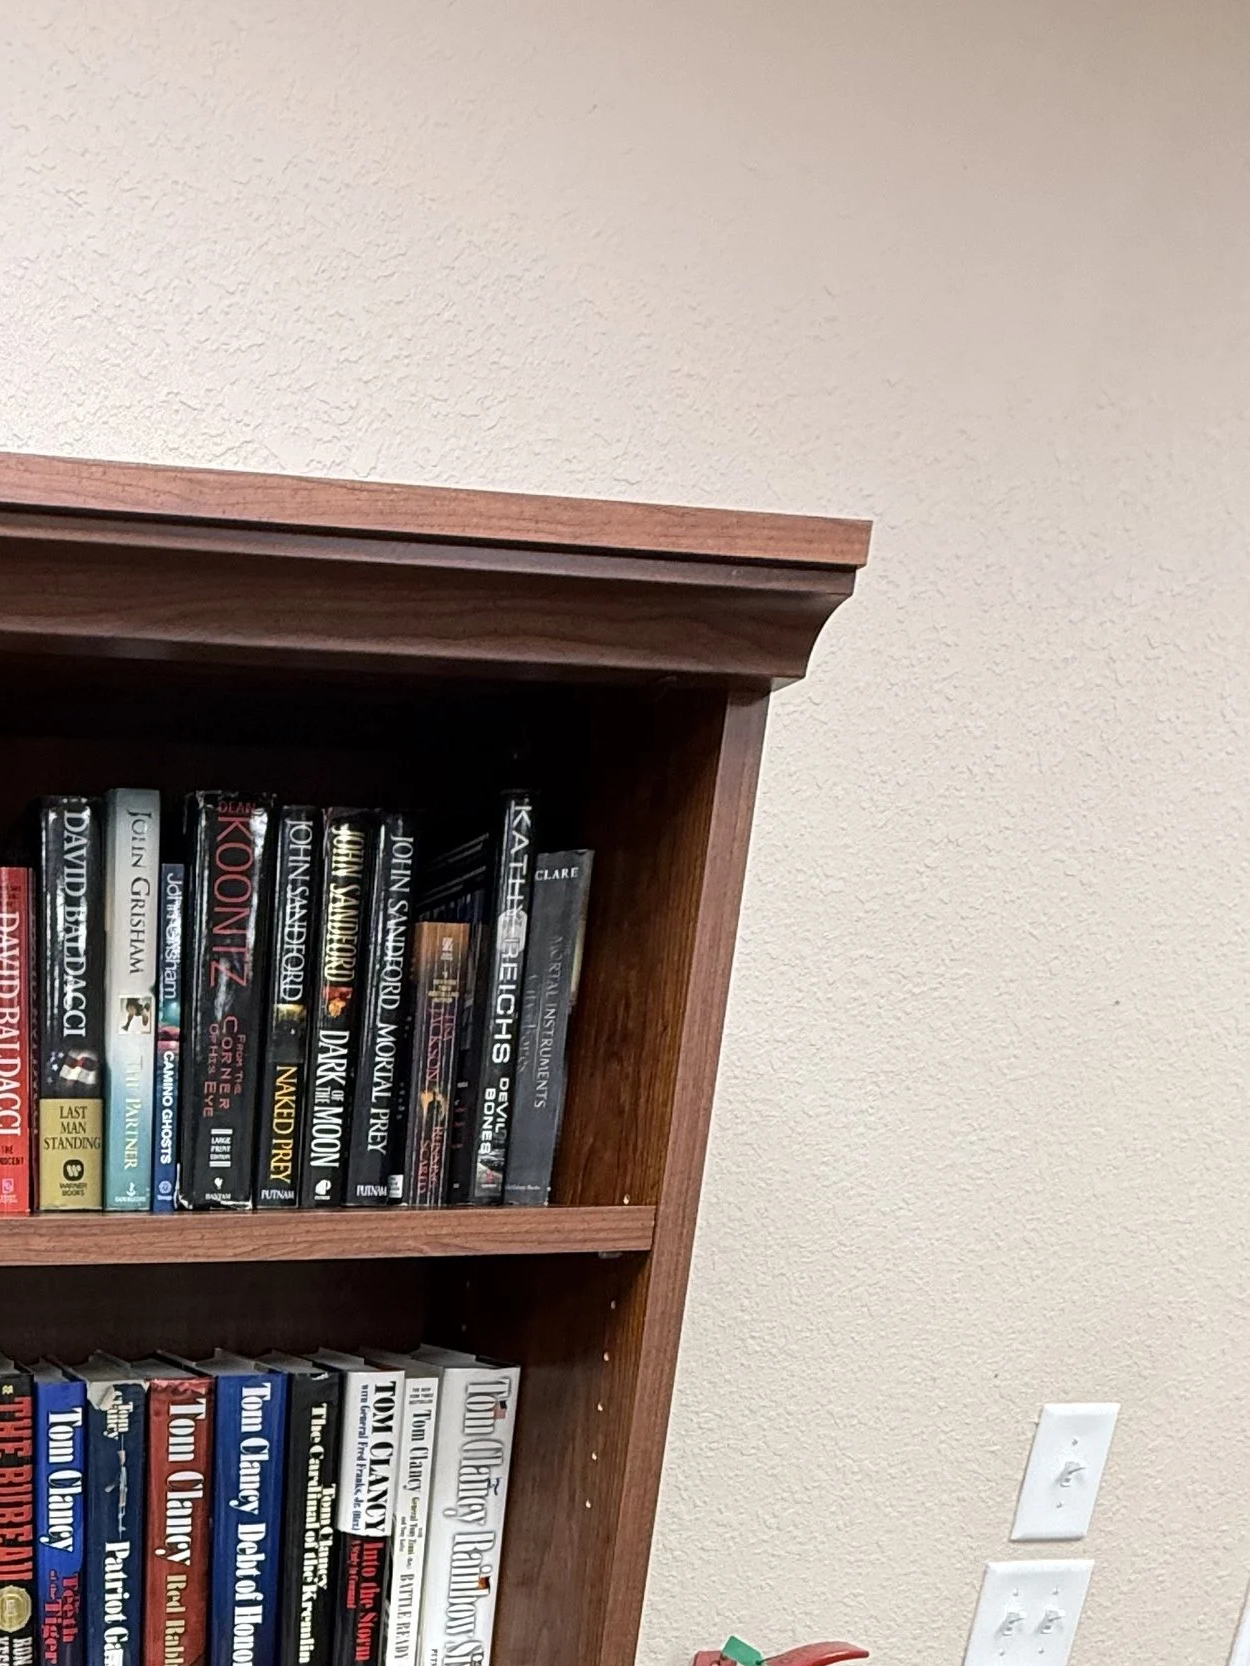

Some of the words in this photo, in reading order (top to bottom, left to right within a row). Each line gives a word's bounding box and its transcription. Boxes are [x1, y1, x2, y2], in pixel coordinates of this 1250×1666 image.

[127, 808, 151, 868] JOHN
[129, 878, 149, 974] GRISHAM
[315, 1030, 349, 1086] DARK
[371, 1022, 399, 1102] MORTAL
[59, 1106, 87, 1118] LAST
[272, 1066, 297, 1134] NAKED
[314, 1086, 331, 1105] THE
[332, 1091, 344, 1101] OF
[44, 1136, 100, 1149] STANDING
[61, 1122, 86, 1134] MAN
[310, 1105, 343, 1168] MOON
[367, 1107, 390, 1155] PREY
[270, 1139, 293, 1184] PREY
[261, 1190, 294, 1200] PUTNAM
[168, 1398, 207, 1462] Tom
[241, 1383, 271, 1433] Tom
[309, 1403, 328, 1444] The
[372, 1381, 396, 1434] TOM
[411, 1409, 432, 1442] Tom
[49, 1407, 82, 1463] Tom
[229, 1437, 270, 1515] Clancy
[305, 1445, 324, 1530] Cardinal
[365, 1441, 394, 1533] CLANCY
[403, 1446, 430, 1493] Clancy
[40, 1470, 82, 1552] Clancy
[155, 1471, 204, 1566] Clancy
[235, 1523, 266, 1578] Debt
[304, 1531, 318, 1550] of
[166, 1574, 187, 1614] Red
[303, 1552, 318, 1583] the
[298, 1584, 317, 1664] Kremlin
